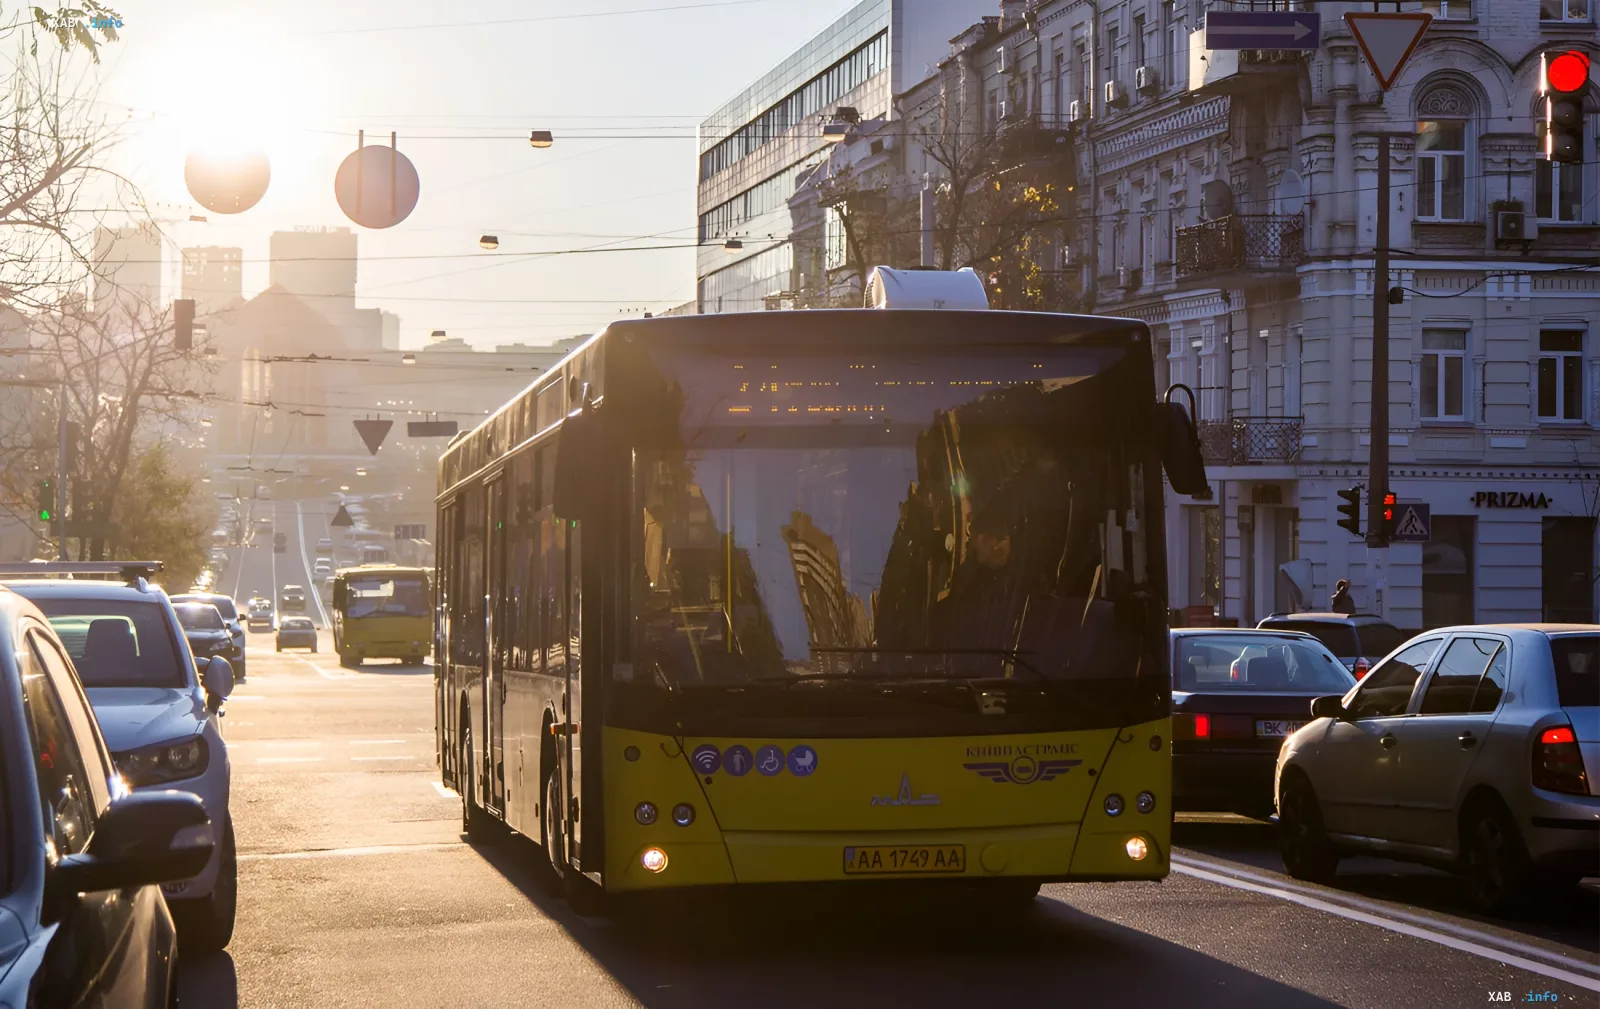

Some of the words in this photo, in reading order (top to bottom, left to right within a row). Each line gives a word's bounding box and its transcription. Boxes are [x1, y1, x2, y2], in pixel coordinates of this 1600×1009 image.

[1475, 491, 1549, 508] PRIZMA
[858, 849, 883, 869] AA
[889, 849, 930, 869] 1749
[934, 848, 961, 868] AA
